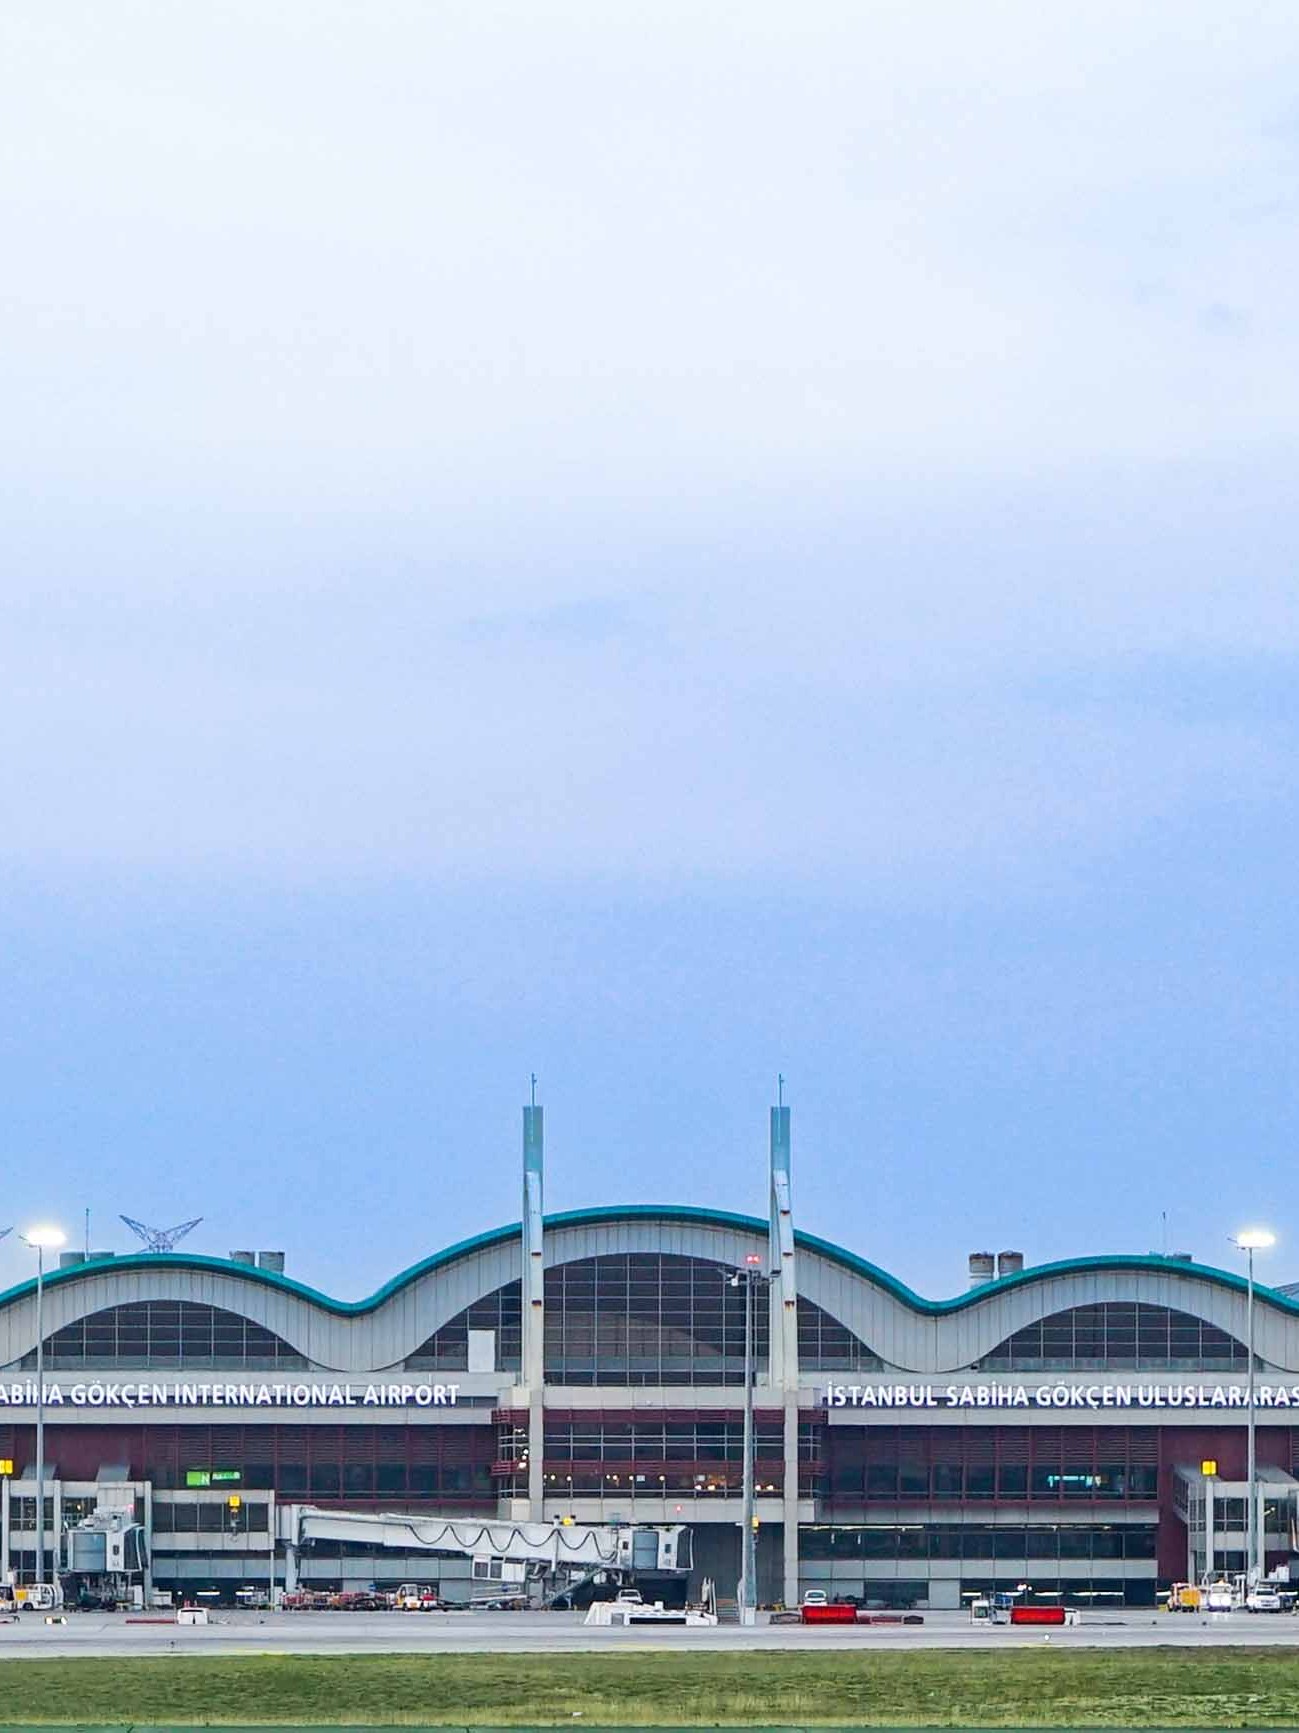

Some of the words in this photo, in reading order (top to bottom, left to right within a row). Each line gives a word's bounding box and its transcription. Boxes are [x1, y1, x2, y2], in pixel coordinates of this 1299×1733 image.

[70, 1380, 168, 1408] GÖKÇEN
[174, 1383, 356, 1405] INTERNATIONAL
[363, 1383, 460, 1405] AIRPORT
[827, 1380, 937, 1406] İSTANBUL
[946, 1380, 1030, 1407] SABİHA
[1035, 1381, 1131, 1410] GÖKÇEN
